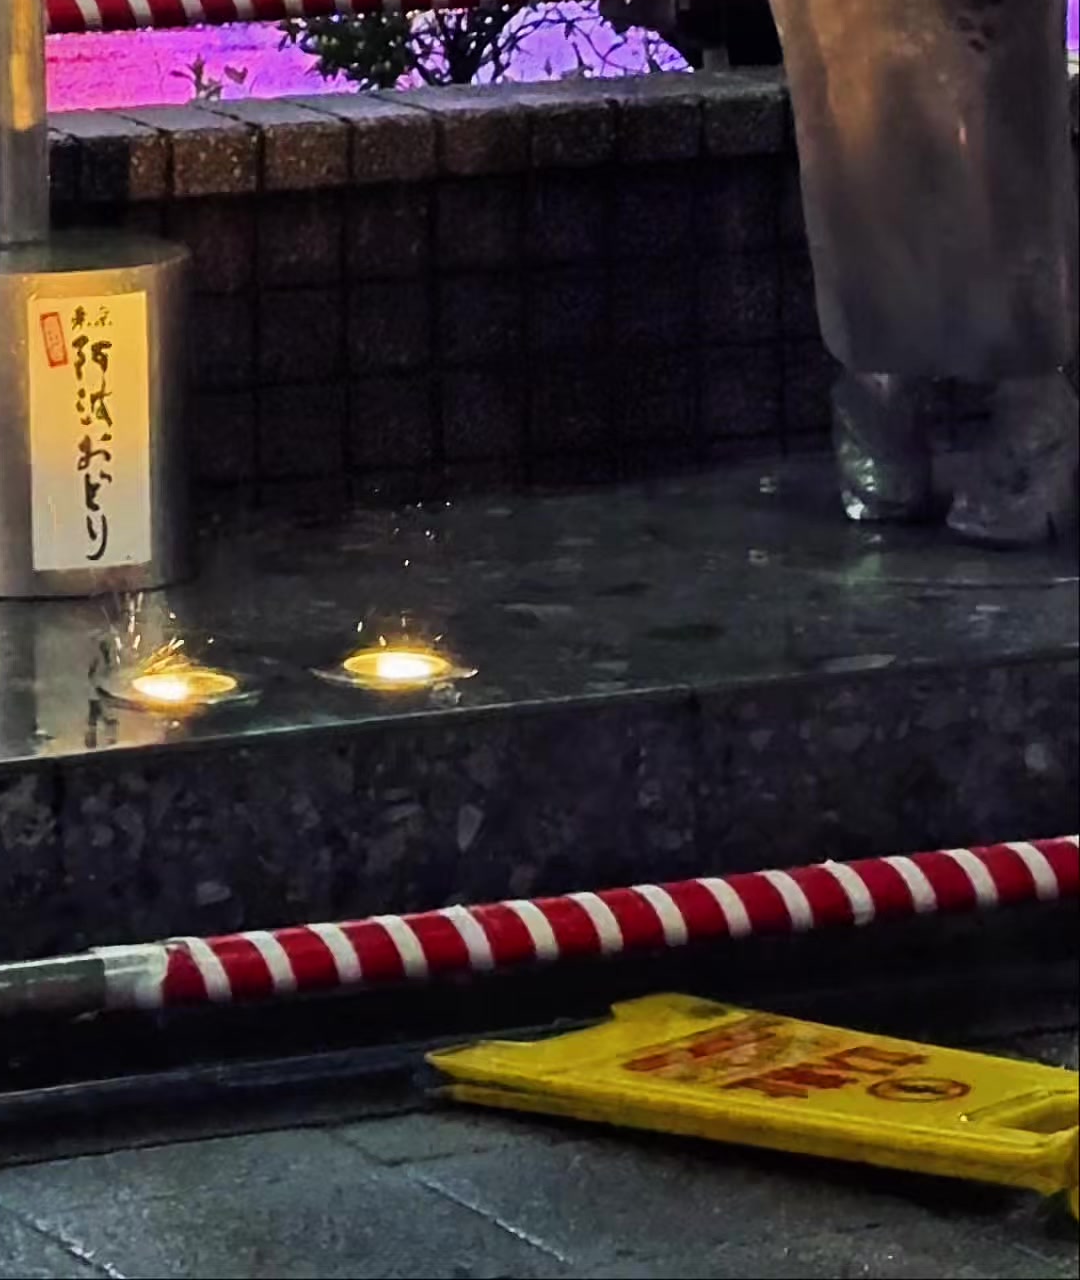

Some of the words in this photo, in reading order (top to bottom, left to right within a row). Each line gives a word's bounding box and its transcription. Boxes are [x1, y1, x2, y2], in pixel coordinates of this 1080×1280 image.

[71, 334, 114, 562] 阿波おどり
